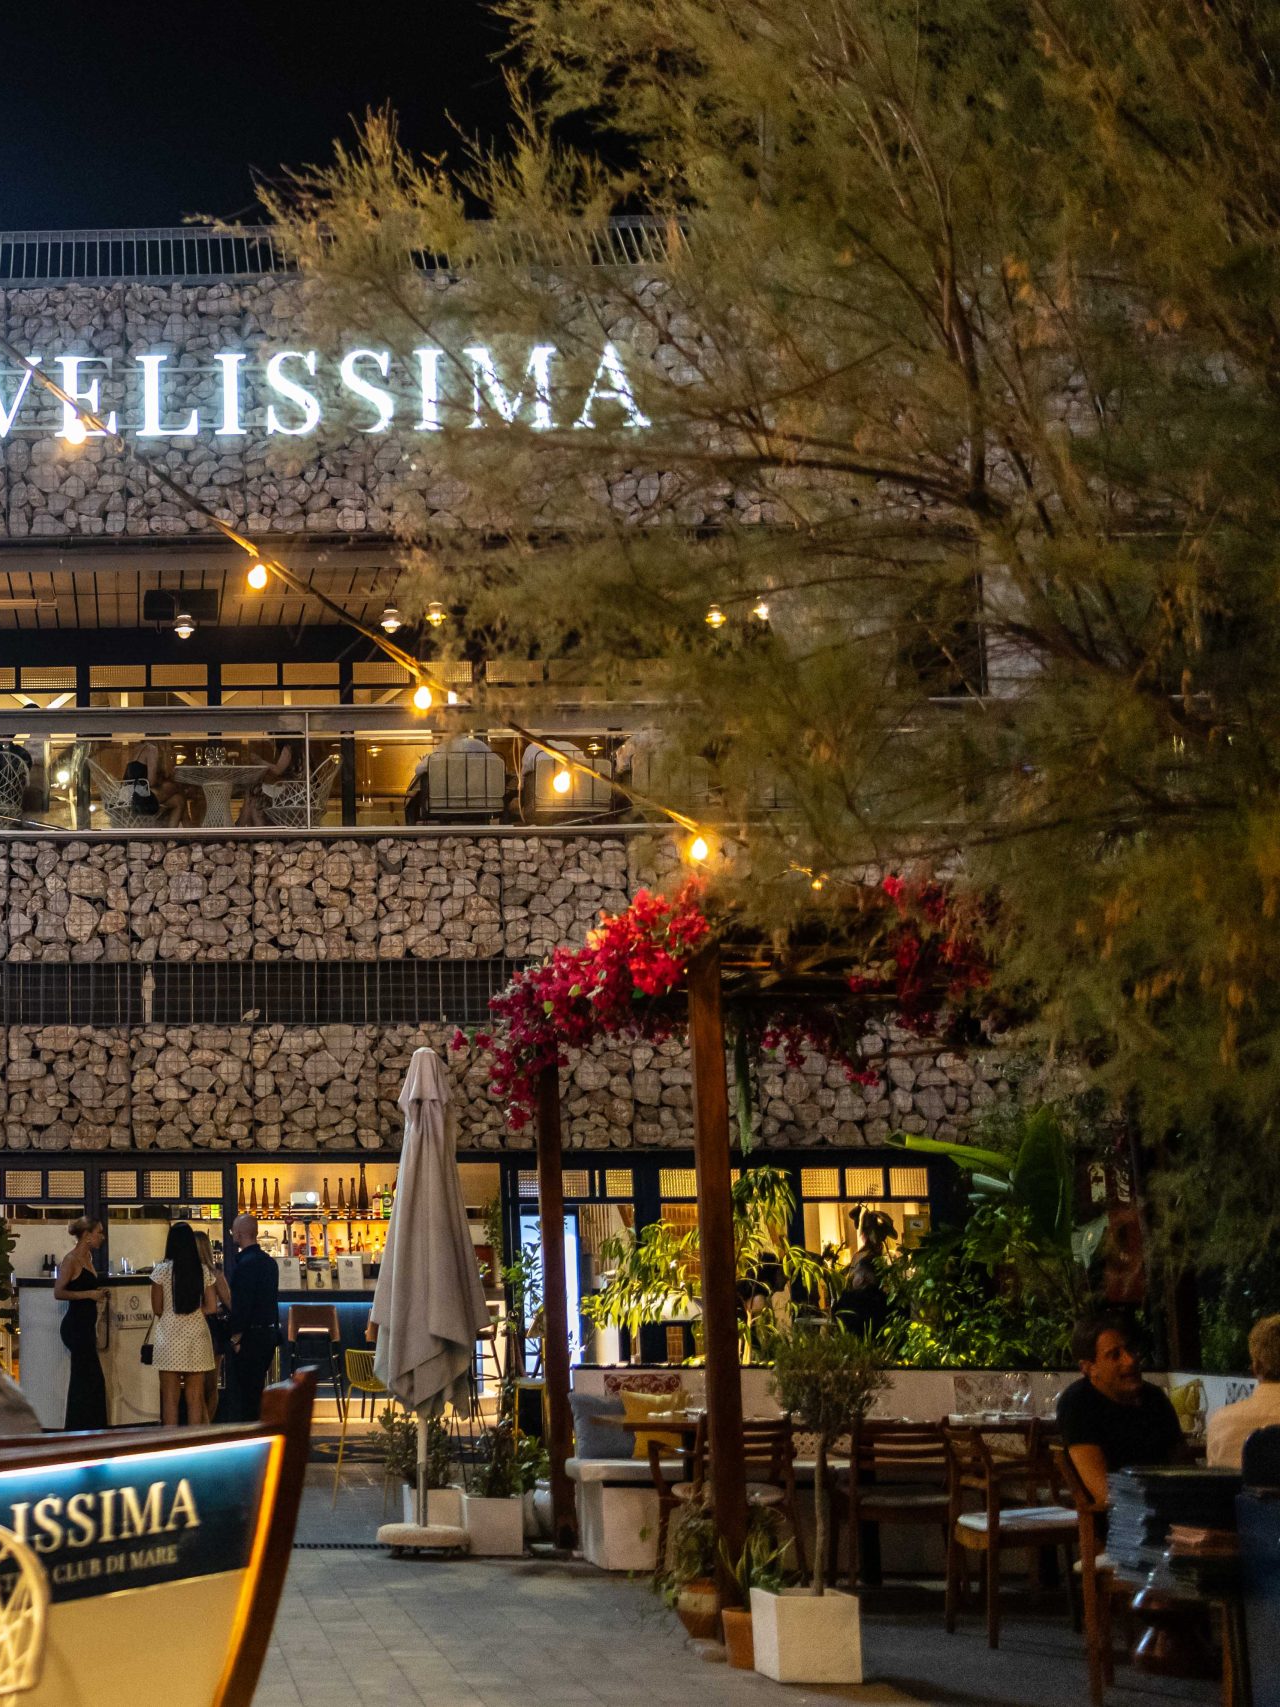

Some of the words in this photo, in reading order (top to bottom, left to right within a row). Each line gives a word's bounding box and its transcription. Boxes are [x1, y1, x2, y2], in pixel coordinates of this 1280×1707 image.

[53, 1557, 101, 1585] CLUB
[106, 1552, 125, 1574] DI
[130, 1543, 177, 1570] MARE
